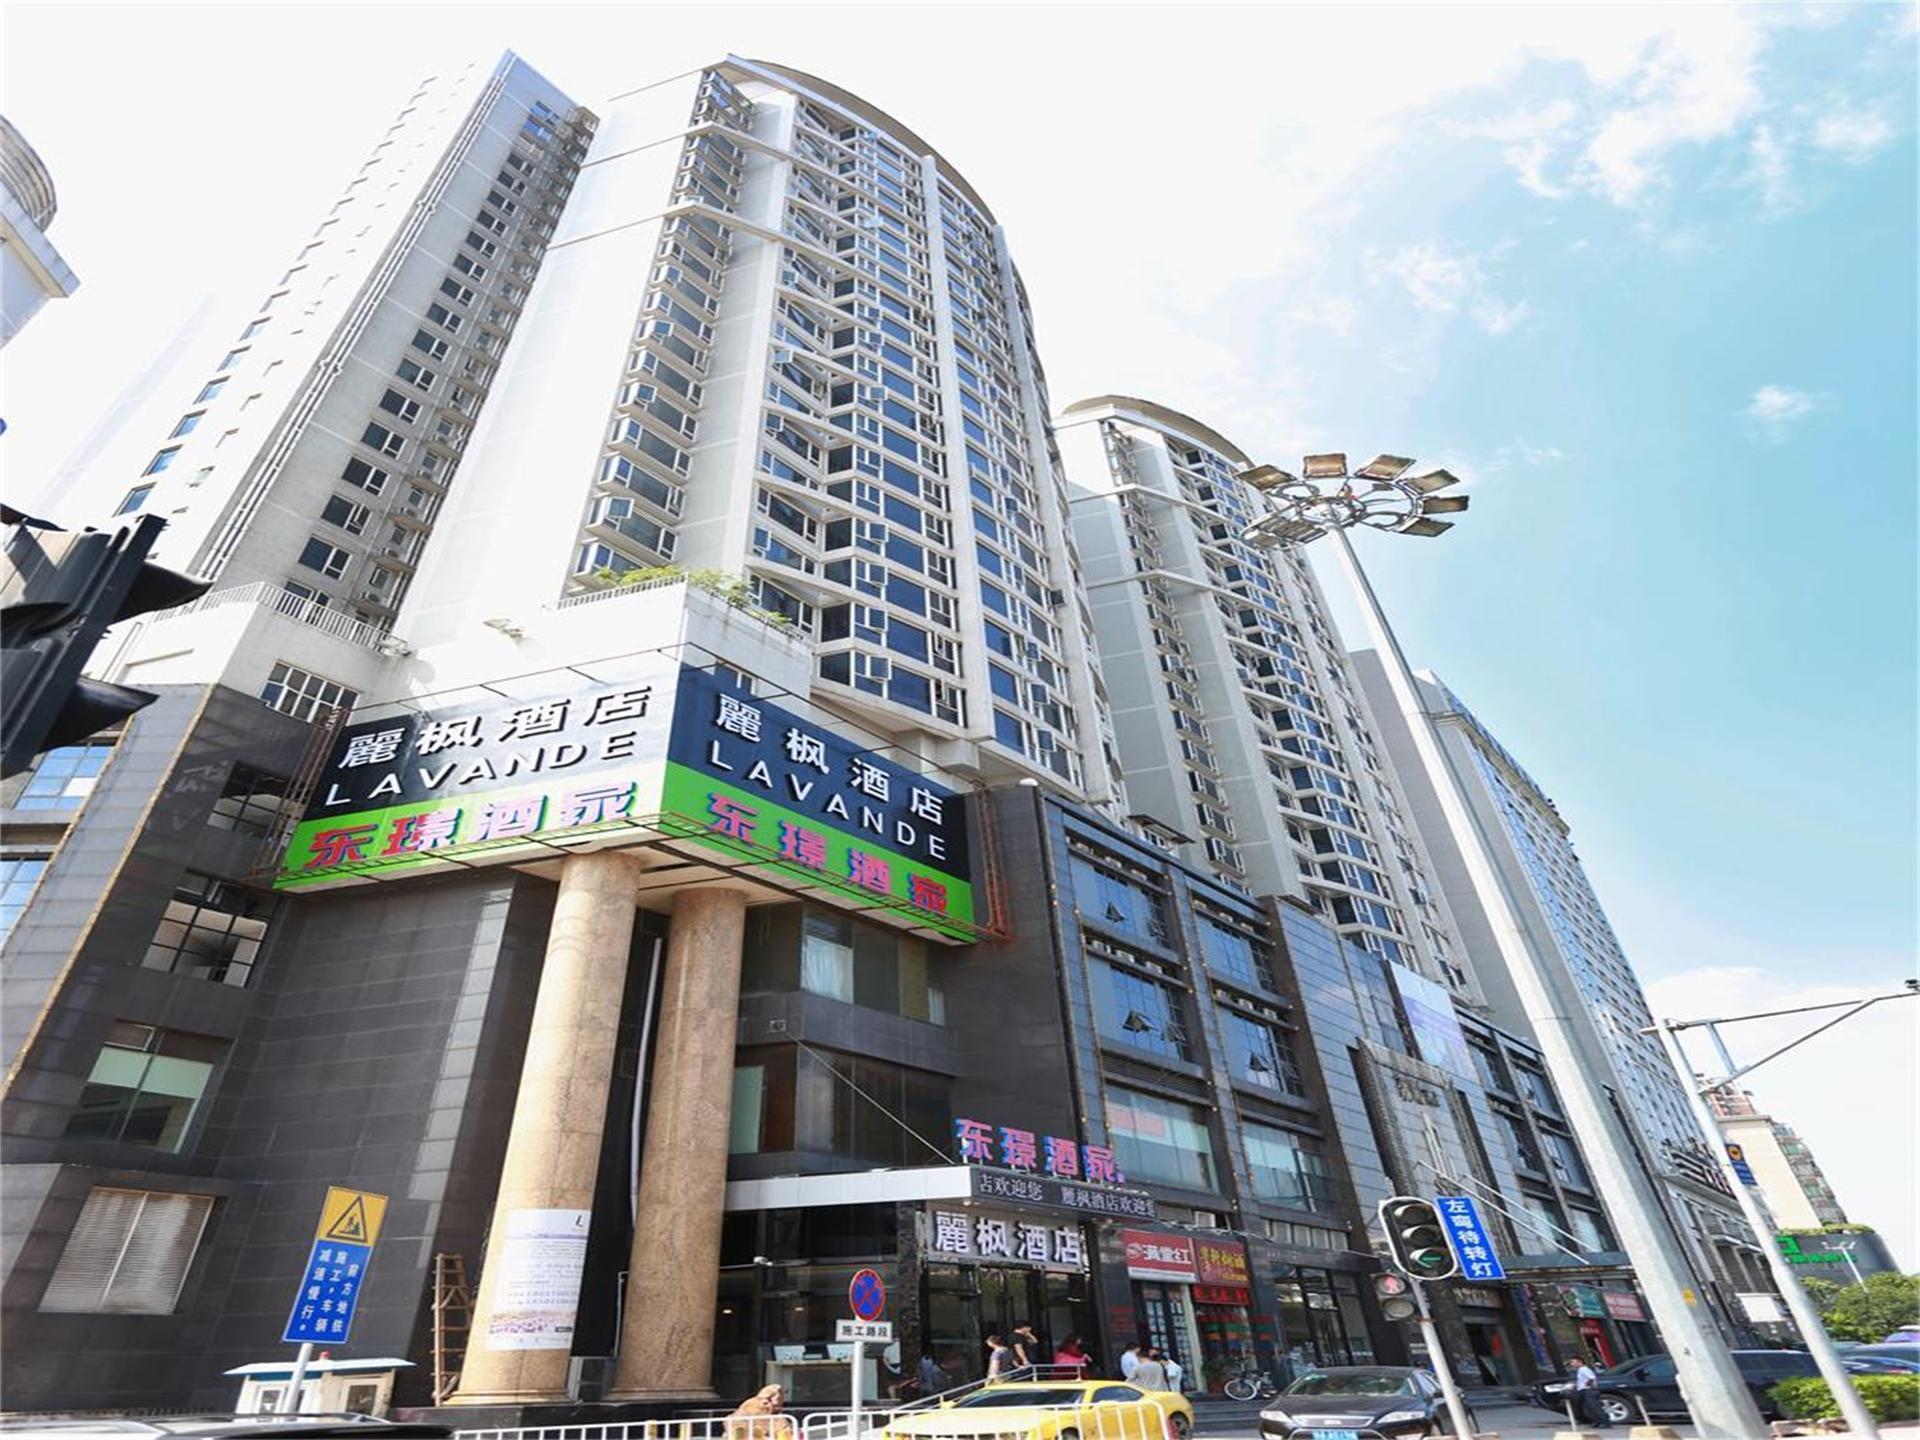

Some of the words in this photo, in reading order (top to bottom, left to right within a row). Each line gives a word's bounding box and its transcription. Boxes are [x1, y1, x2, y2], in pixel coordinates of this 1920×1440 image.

[339, 684, 653, 770] 麗枫酒店
[715, 693, 945, 825] 麗枫酒店
[325, 730, 637, 806] LAVANDE
[711, 740, 947, 861] LAVANDE
[303, 780, 639, 868] 东璟酒家
[706, 792, 949, 917] 东璟酒家
[956, 1118, 1124, 1183] 东璟酒家
[935, 1211, 1081, 1264] 麗枫酒店
[1446, 1199, 1493, 1277] 左弯待转灯
[332, 1264, 359, 1332] 前方地铁
[842, 1325, 888, 1338] 施工路段
